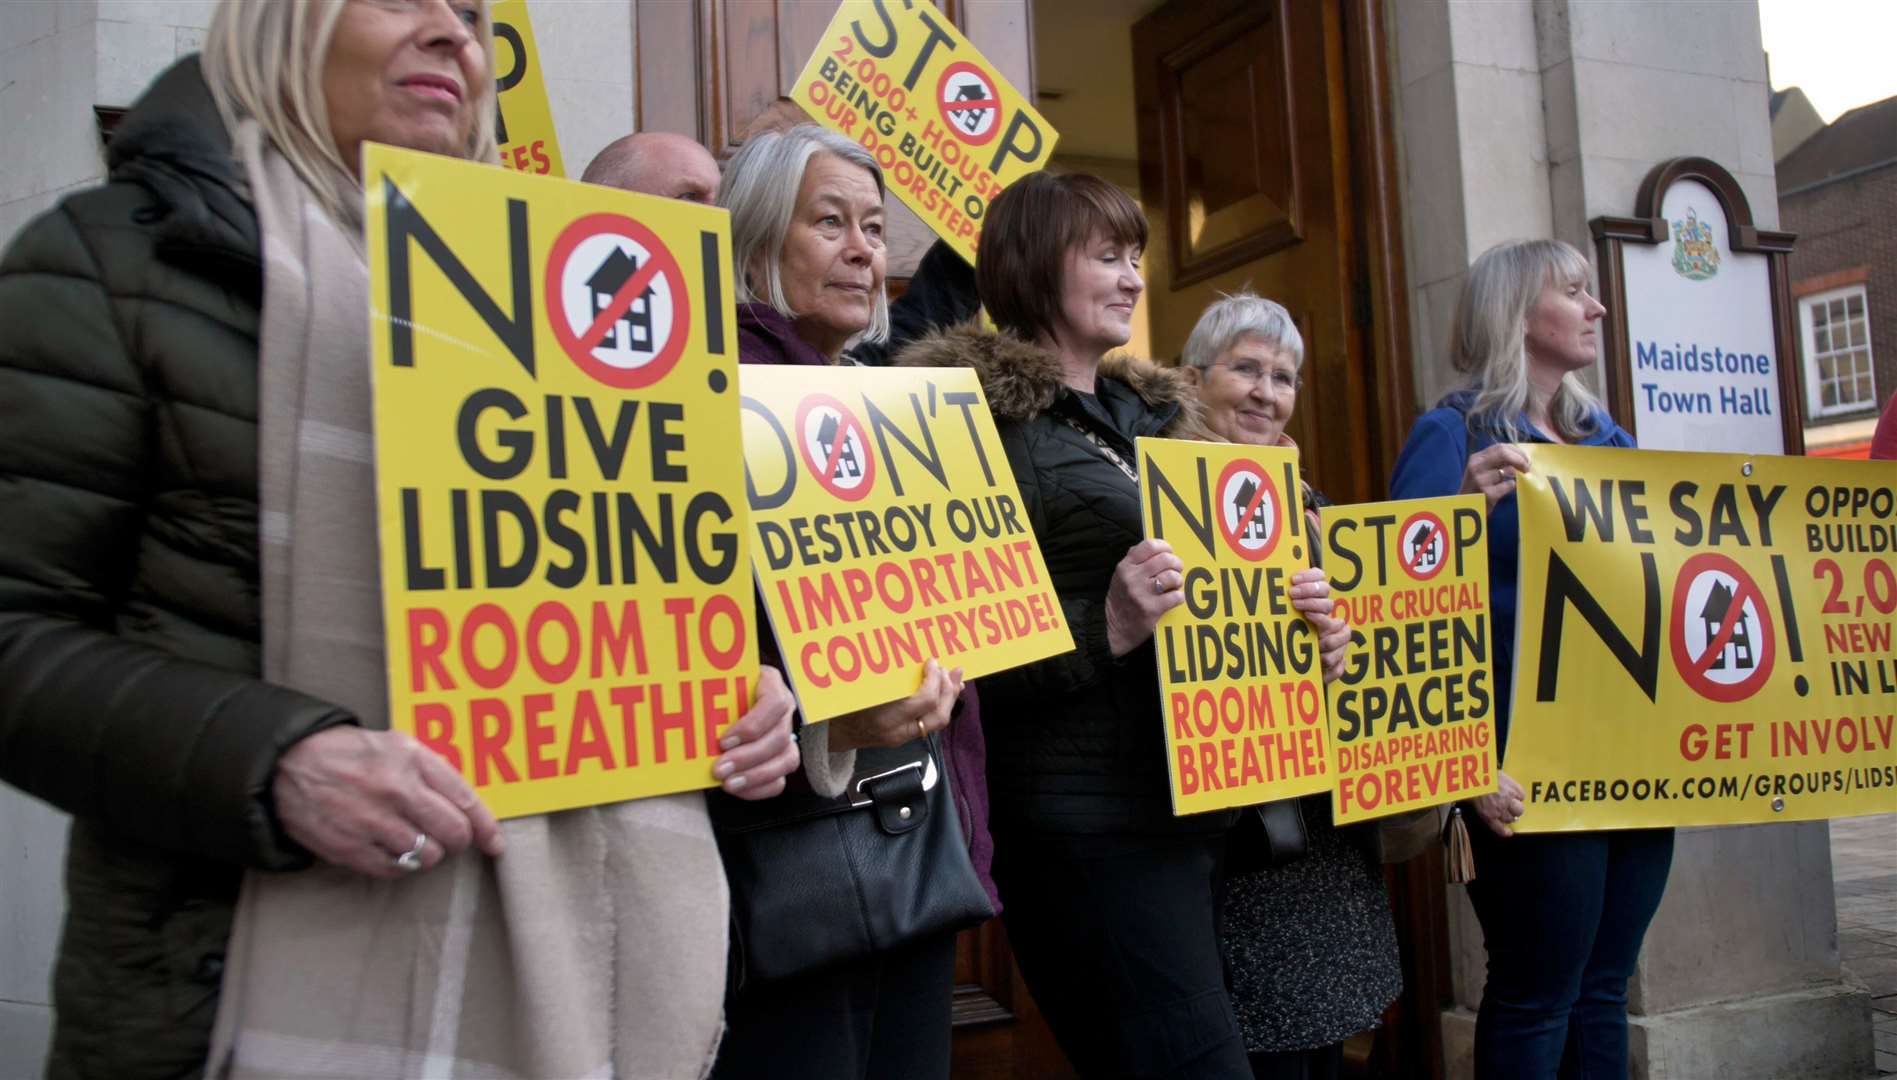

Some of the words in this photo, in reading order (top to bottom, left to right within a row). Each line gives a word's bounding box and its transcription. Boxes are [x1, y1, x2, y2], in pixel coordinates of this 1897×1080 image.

[808, 80, 858, 134] OUR
[832, 36, 918, 121] 2,000+
[819, 56, 897, 137] BEING
[899, 132, 963, 197] BUILT
[1636, 341, 1770, 375] Maidstone
[1641, 383, 1711, 414] Town
[1720, 386, 1771, 415] Hall
[456, 387, 688, 483] GIVE
[740, 381, 996, 511] DON'T
[756, 503, 936, 571] DESTROY
[946, 494, 1026, 543] OUR
[1547, 476, 1655, 544] WE
[1669, 481, 1787, 547] SAY
[1805, 486, 1897, 519] OPPO
[402, 488, 739, 591] LIDSING
[1328, 508, 1482, 592] STOP
[776, 541, 1039, 634] IMPORTANT
[1184, 567, 1287, 619] GIVE
[1331, 595, 1384, 626] OUR
[1390, 582, 1483, 621] CRUCIAL
[407, 600, 649, 692] ROOM
[664, 594, 746, 672] TO
[801, 592, 1059, 689] COUNTRYSIDE!
[1165, 618, 1313, 683] LIDSING
[1339, 613, 1486, 685] GREEN
[1823, 622, 1892, 655] NEW
[1171, 684, 1274, 740] ROOM
[1281, 679, 1319, 726] TO
[1337, 669, 1489, 742] SPACES
[1830, 660, 1869, 696] IN
[1177, 728, 1326, 795] BREATHE!
[1338, 721, 1489, 773] DISAPPEARING
[1680, 723, 1754, 761] GET
[1339, 751, 1490, 815] FOREVER!
[1531, 767, 1897, 803] FACEBOOK.COM/GROUPS/LIDS
